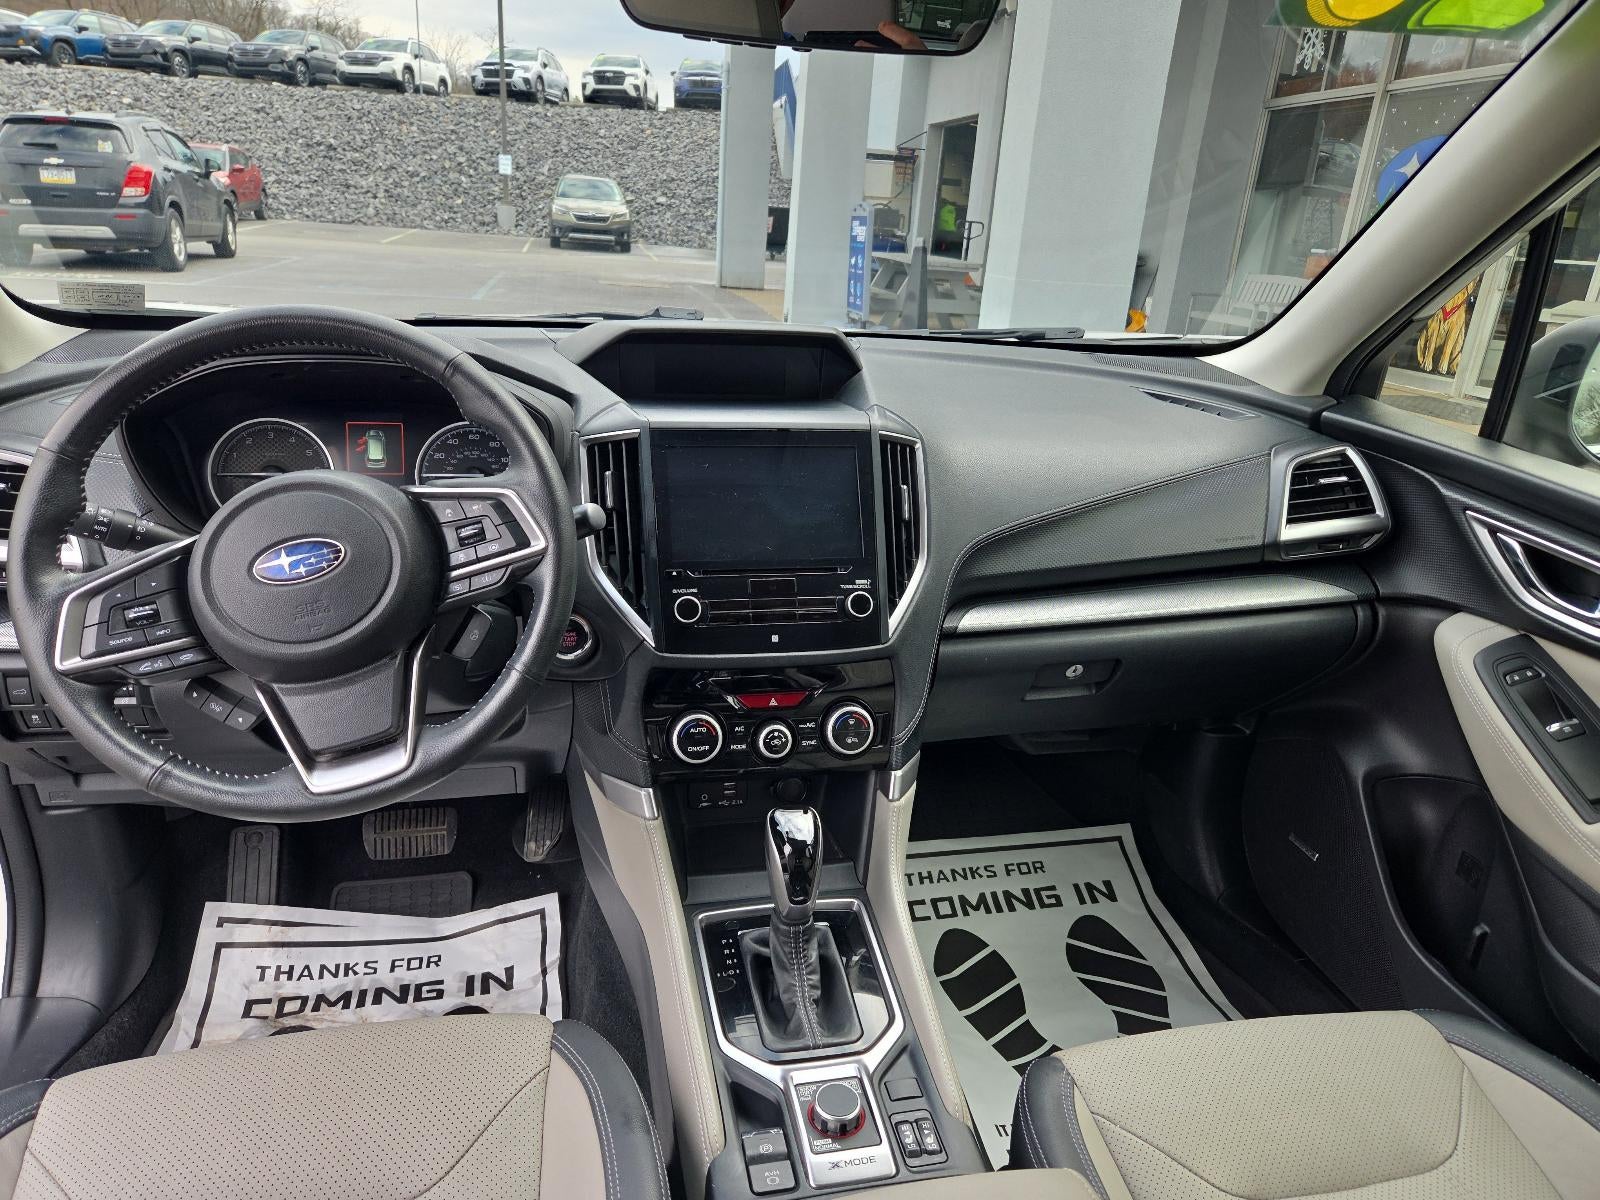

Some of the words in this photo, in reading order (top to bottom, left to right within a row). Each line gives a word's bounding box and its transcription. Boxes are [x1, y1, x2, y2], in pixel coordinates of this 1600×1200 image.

[904, 865, 998, 887] THANKS
[1003, 860, 1047, 877] FOR
[907, 885, 1064, 923] COMING
[1072, 879, 1119, 905] IN
[256, 960, 379, 982] THANKS
[389, 954, 443, 974] FOR
[240, 979, 445, 1020] COMING
[464, 964, 516, 998] IN
